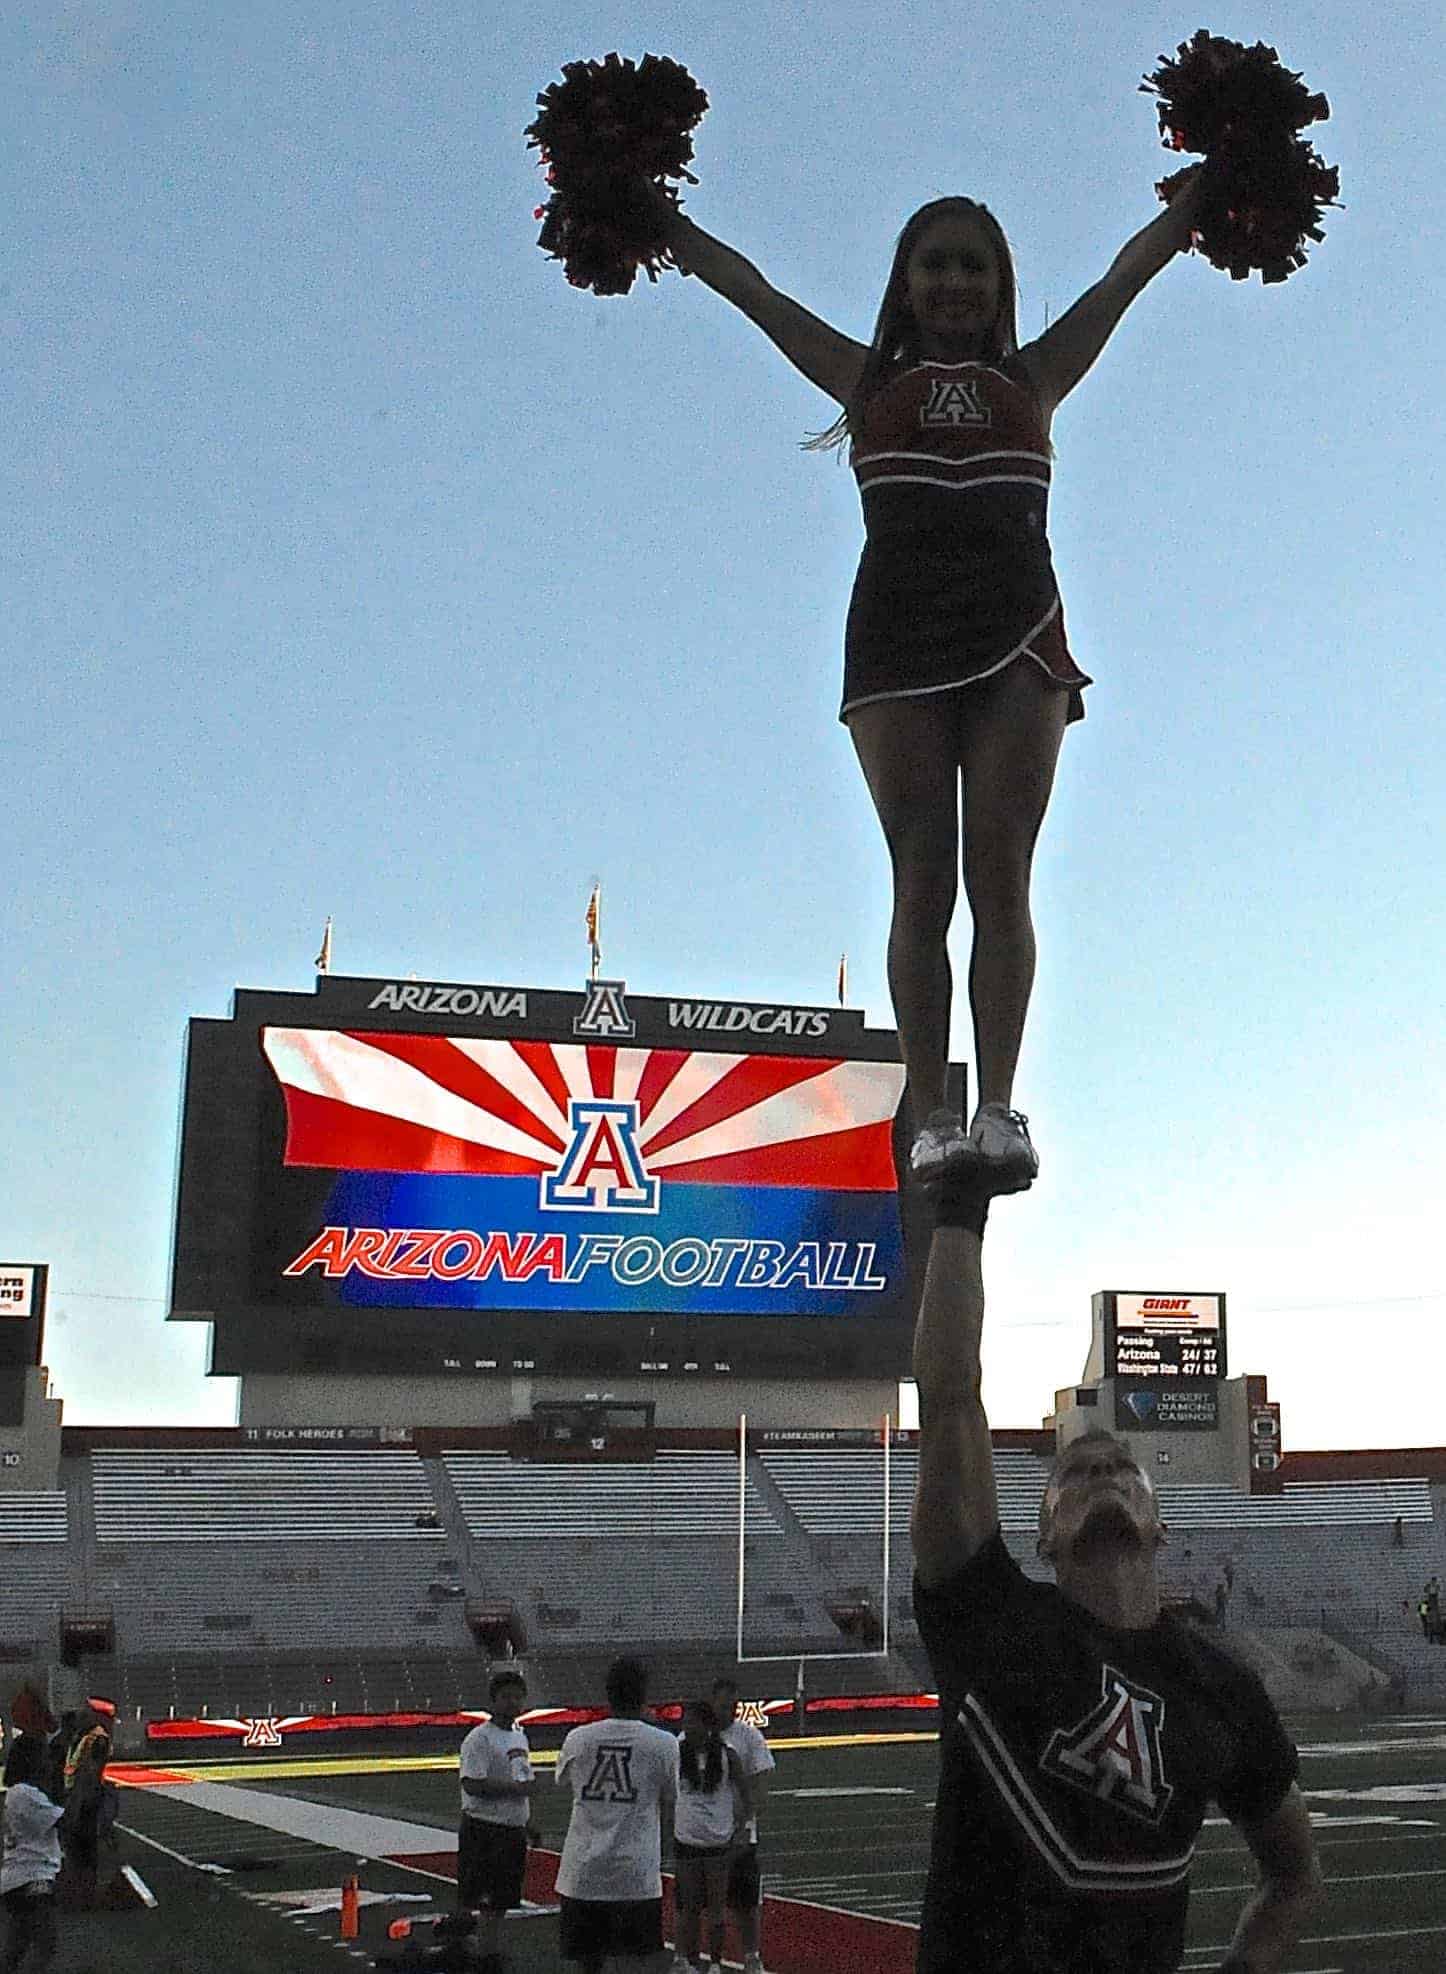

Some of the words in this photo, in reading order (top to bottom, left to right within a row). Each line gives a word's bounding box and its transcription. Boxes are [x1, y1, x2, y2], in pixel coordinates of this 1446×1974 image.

[368, 984, 528, 1019] ARIZONA
[573, 980, 635, 1038] A
[668, 1002, 830, 1036] WILDCATS
[538, 1095, 661, 1215] A
[1143, 1299, 1191, 1310] GIANT
[1117, 1335, 1154, 1348] Passing
[1117, 1348, 1161, 1360] Arizona
[1203, 1349, 1217, 1360] 37
[1162, 1393, 1210, 1402] DESERT
[1157, 1403, 1216, 1412] DIAMOND
[1158, 1413, 1214, 1421] CASINOS
[266, 1429, 295, 1439] FOLK
[299, 1429, 344, 1439] HEROES
[5, 1454, 20, 1466] 10
[1039, 1664, 1173, 1824] A
[582, 1746, 638, 1800] A
